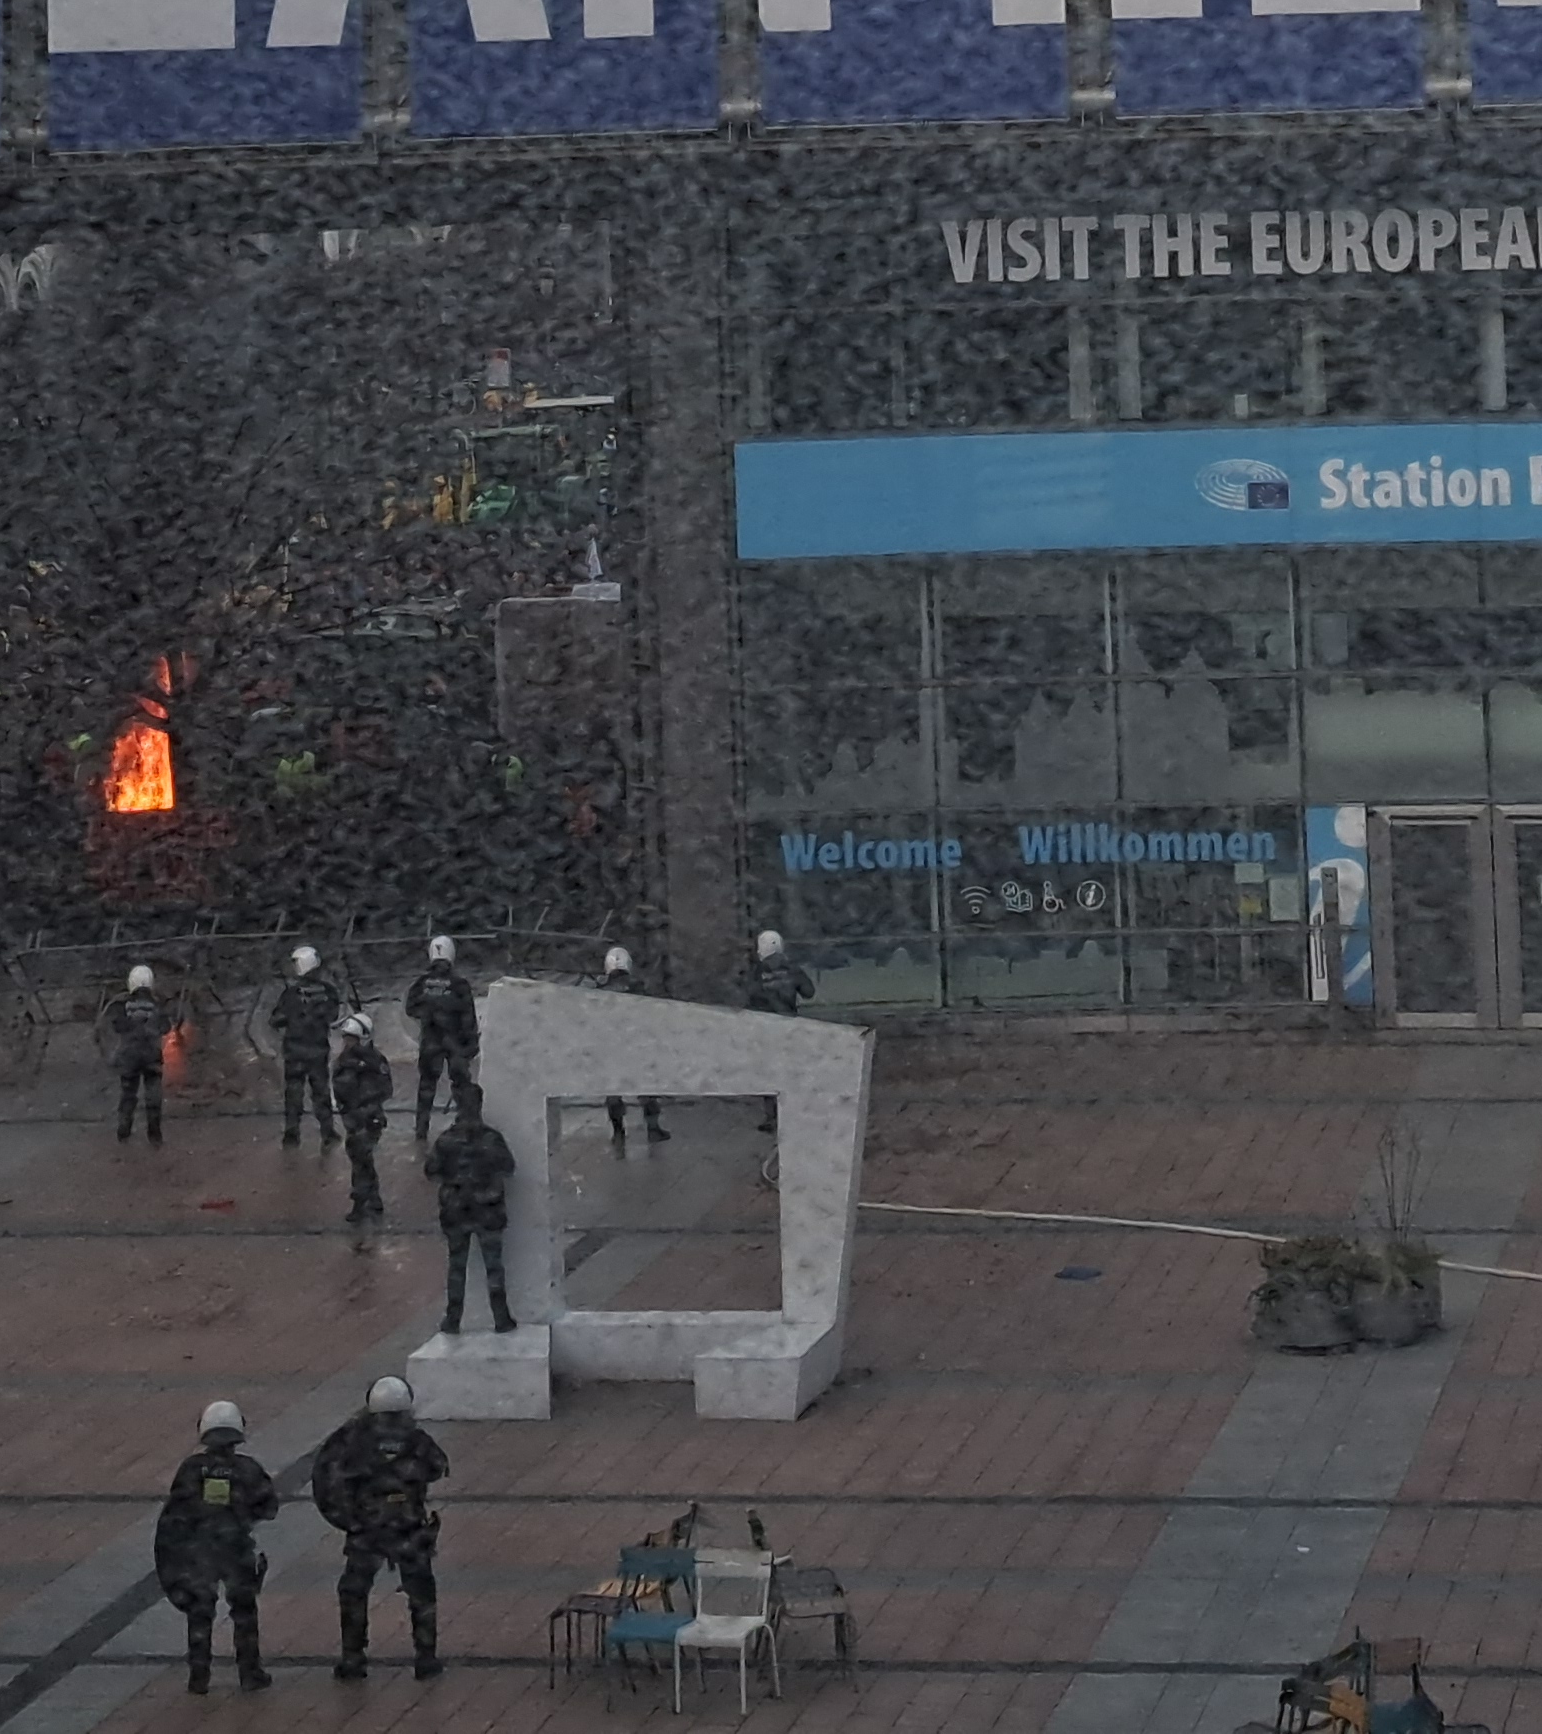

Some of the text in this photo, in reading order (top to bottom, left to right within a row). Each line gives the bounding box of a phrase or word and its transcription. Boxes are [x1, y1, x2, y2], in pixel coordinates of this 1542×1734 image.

[941, 215, 1099, 283] VISIT
[1113, 211, 1232, 278] THE
[1319, 455, 1512, 510] Station
[780, 830, 963, 874] Welcome
[1018, 822, 1277, 865] Willkommen
